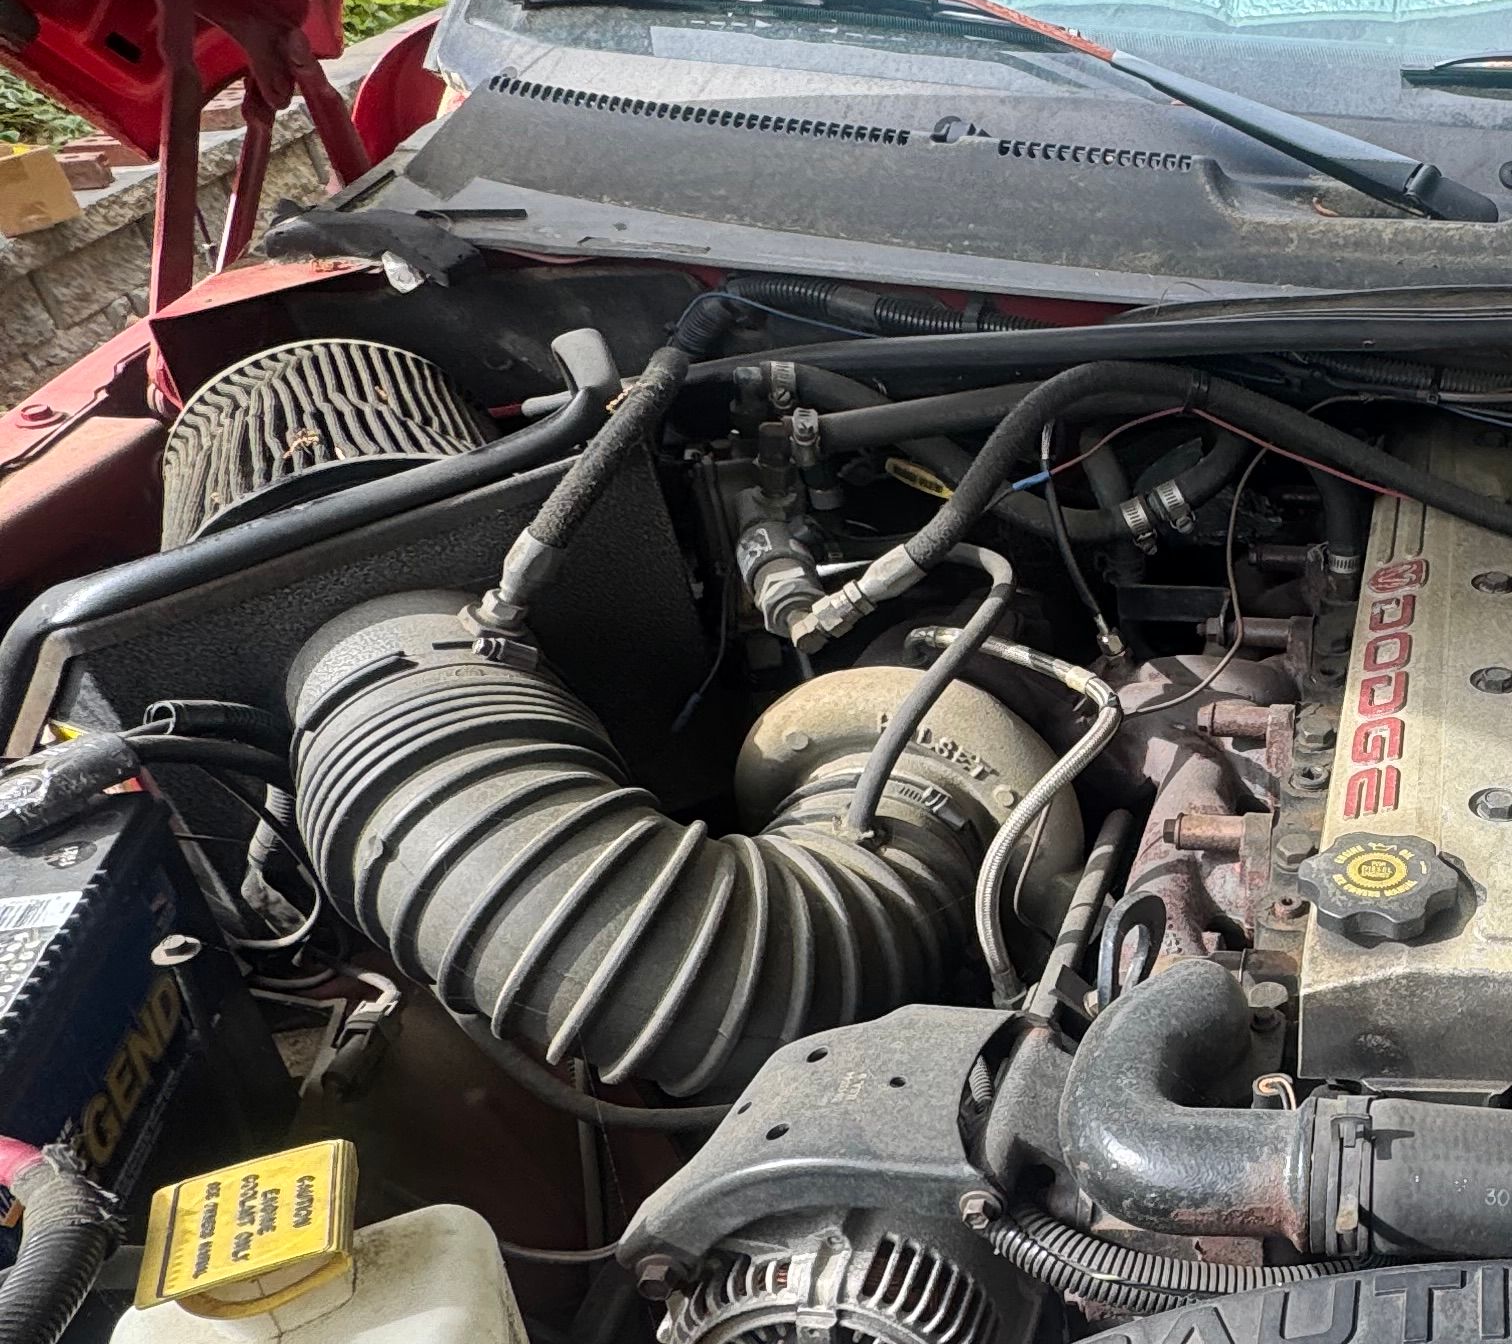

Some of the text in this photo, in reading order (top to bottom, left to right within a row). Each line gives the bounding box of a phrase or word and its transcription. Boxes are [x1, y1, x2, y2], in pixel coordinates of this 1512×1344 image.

[876, 710, 1001, 782] HLSET
[1343, 592, 1416, 821] DODGE
[82, 970, 184, 1168] GEND
